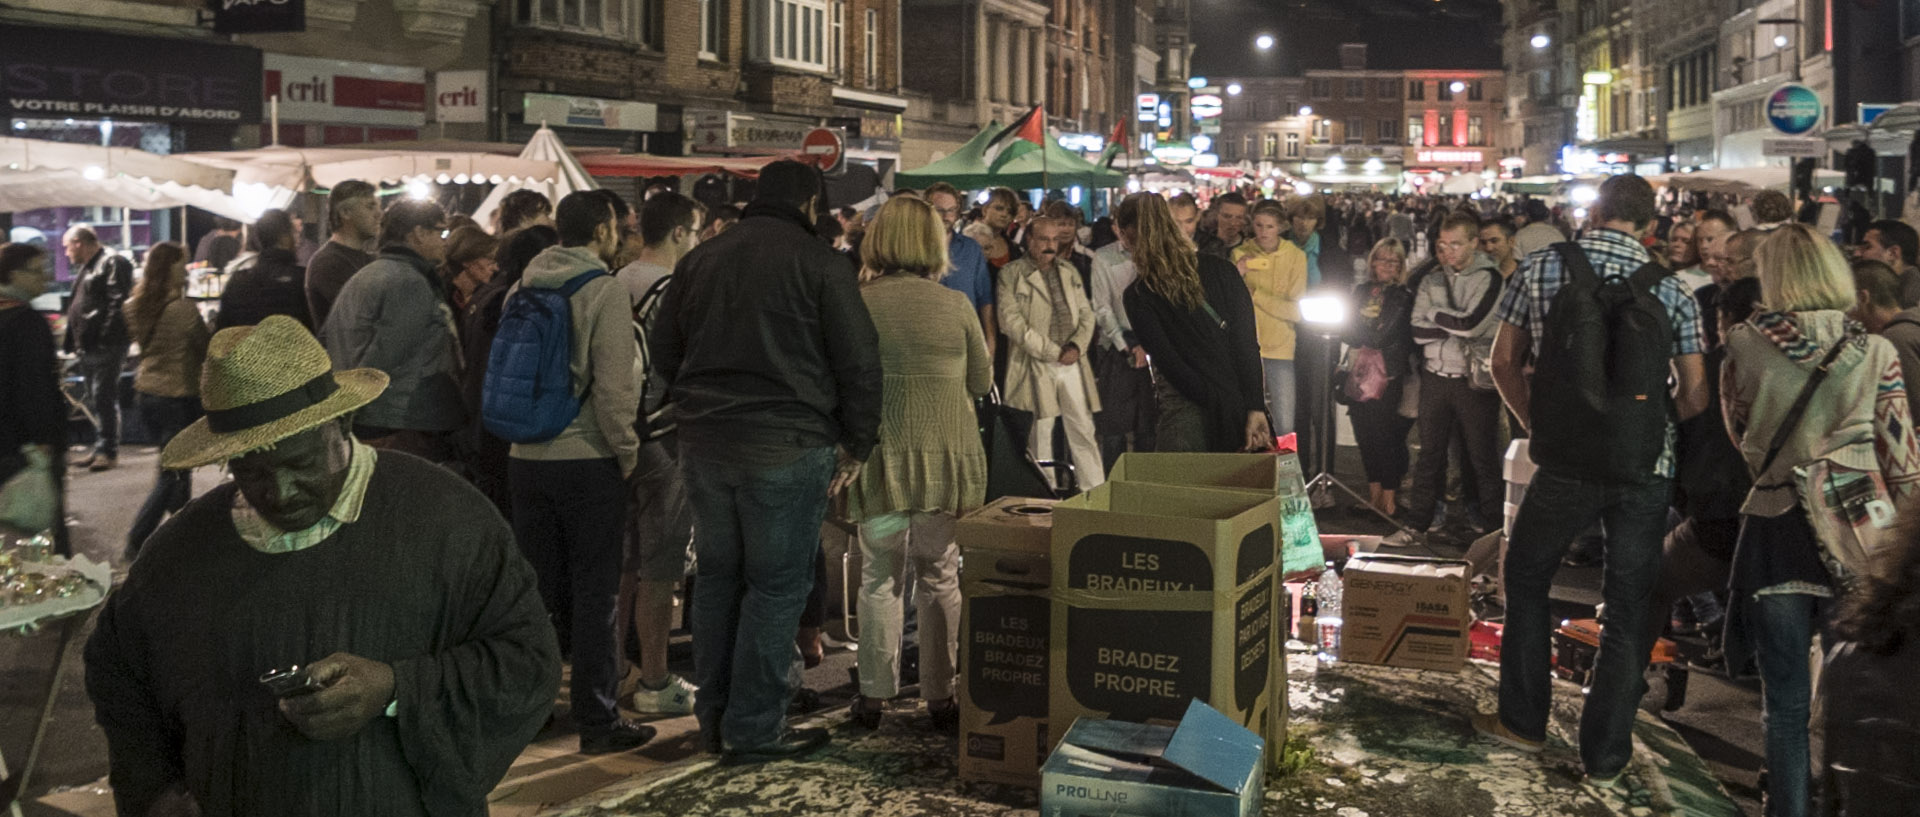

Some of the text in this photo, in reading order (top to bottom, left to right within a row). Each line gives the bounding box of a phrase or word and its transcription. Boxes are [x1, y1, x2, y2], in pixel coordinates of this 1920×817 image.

[287, 76, 327, 103] crit
[439, 86, 478, 107] crit
[10, 98, 241, 120] VOTRE PLAISIR D'ABORD
[1121, 551, 1160, 571] LES
[1415, 601, 1449, 613] ISASA
[1001, 616, 1028, 631] LES
[975, 631, 1046, 650] BRADEUX
[984, 650, 1044, 668] BRADEZ
[1097, 647, 1180, 673] BRADEZ
[982, 667, 1046, 686] PROPRE.
[1094, 672, 1181, 698] PROPRE.
